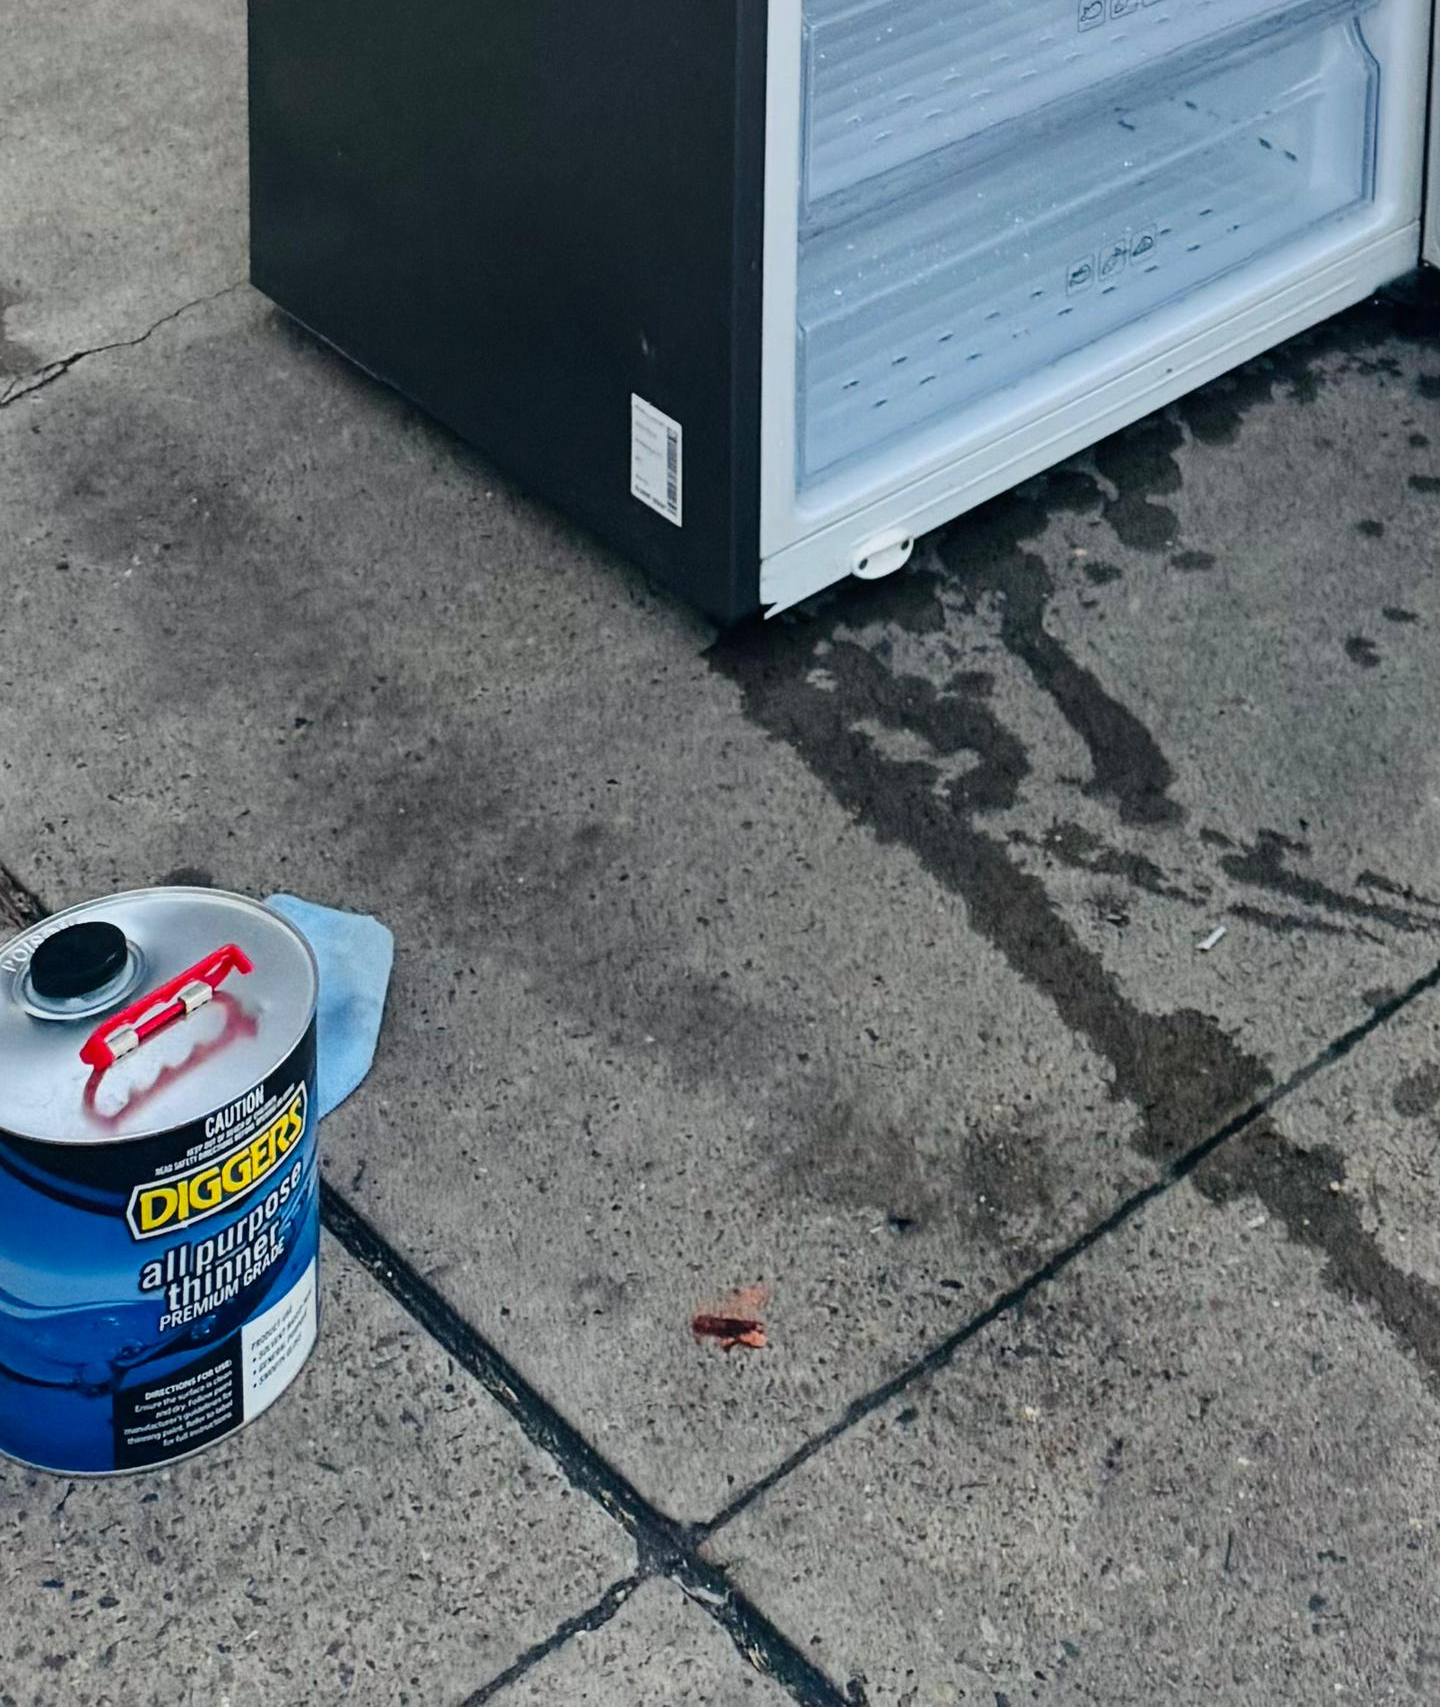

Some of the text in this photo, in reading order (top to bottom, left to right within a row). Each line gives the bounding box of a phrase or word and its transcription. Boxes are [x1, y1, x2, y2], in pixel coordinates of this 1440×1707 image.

[205, 1084, 264, 1137] CAUTION
[140, 1096, 302, 1230] DIGGERS
[155, 1163, 173, 1176] READ
[174, 1154, 198, 1171] SAFETY
[142, 1161, 301, 1290] all purpose
[159, 1277, 240, 1332] PREMIUM
[243, 1236, 285, 1287] GRADE
[168, 1220, 280, 1312] thinner
[134, 1401, 162, 1413] Ensure
[163, 1396, 177, 1406] the
[178, 1385, 205, 1400] surface
[213, 1370, 233, 1385] clean
[145, 1377, 196, 1401] DIRECTIONS
[197, 1368, 214, 1383] FOR
[155, 1407, 172, 1418] and
[188, 1391, 213, 1407] Follow
[163, 1438, 175, 1447] for
[175, 1432, 189, 1442] full
